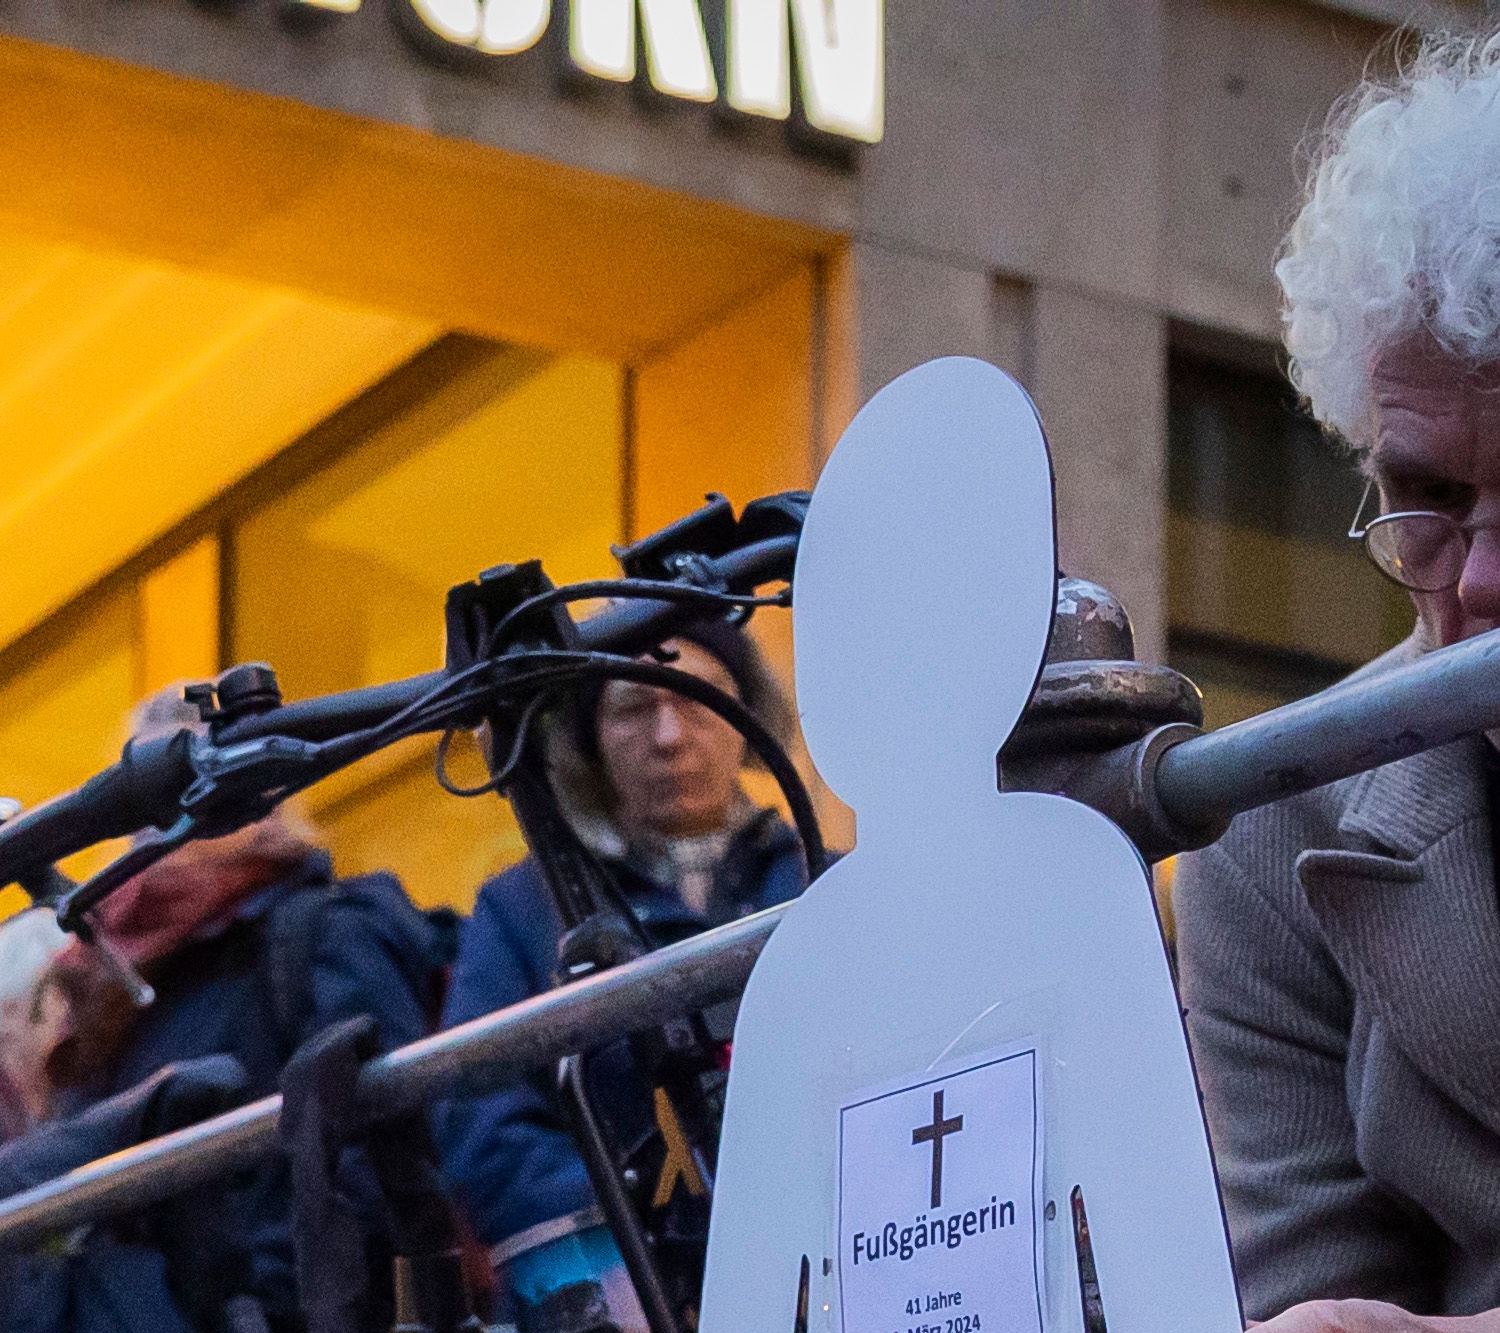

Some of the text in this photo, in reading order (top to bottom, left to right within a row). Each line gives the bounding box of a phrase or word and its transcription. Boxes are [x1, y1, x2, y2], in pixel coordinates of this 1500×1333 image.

[853, 1195, 1015, 1266] Fußgängerin
[905, 1291, 962, 1316] 41 Jahre
